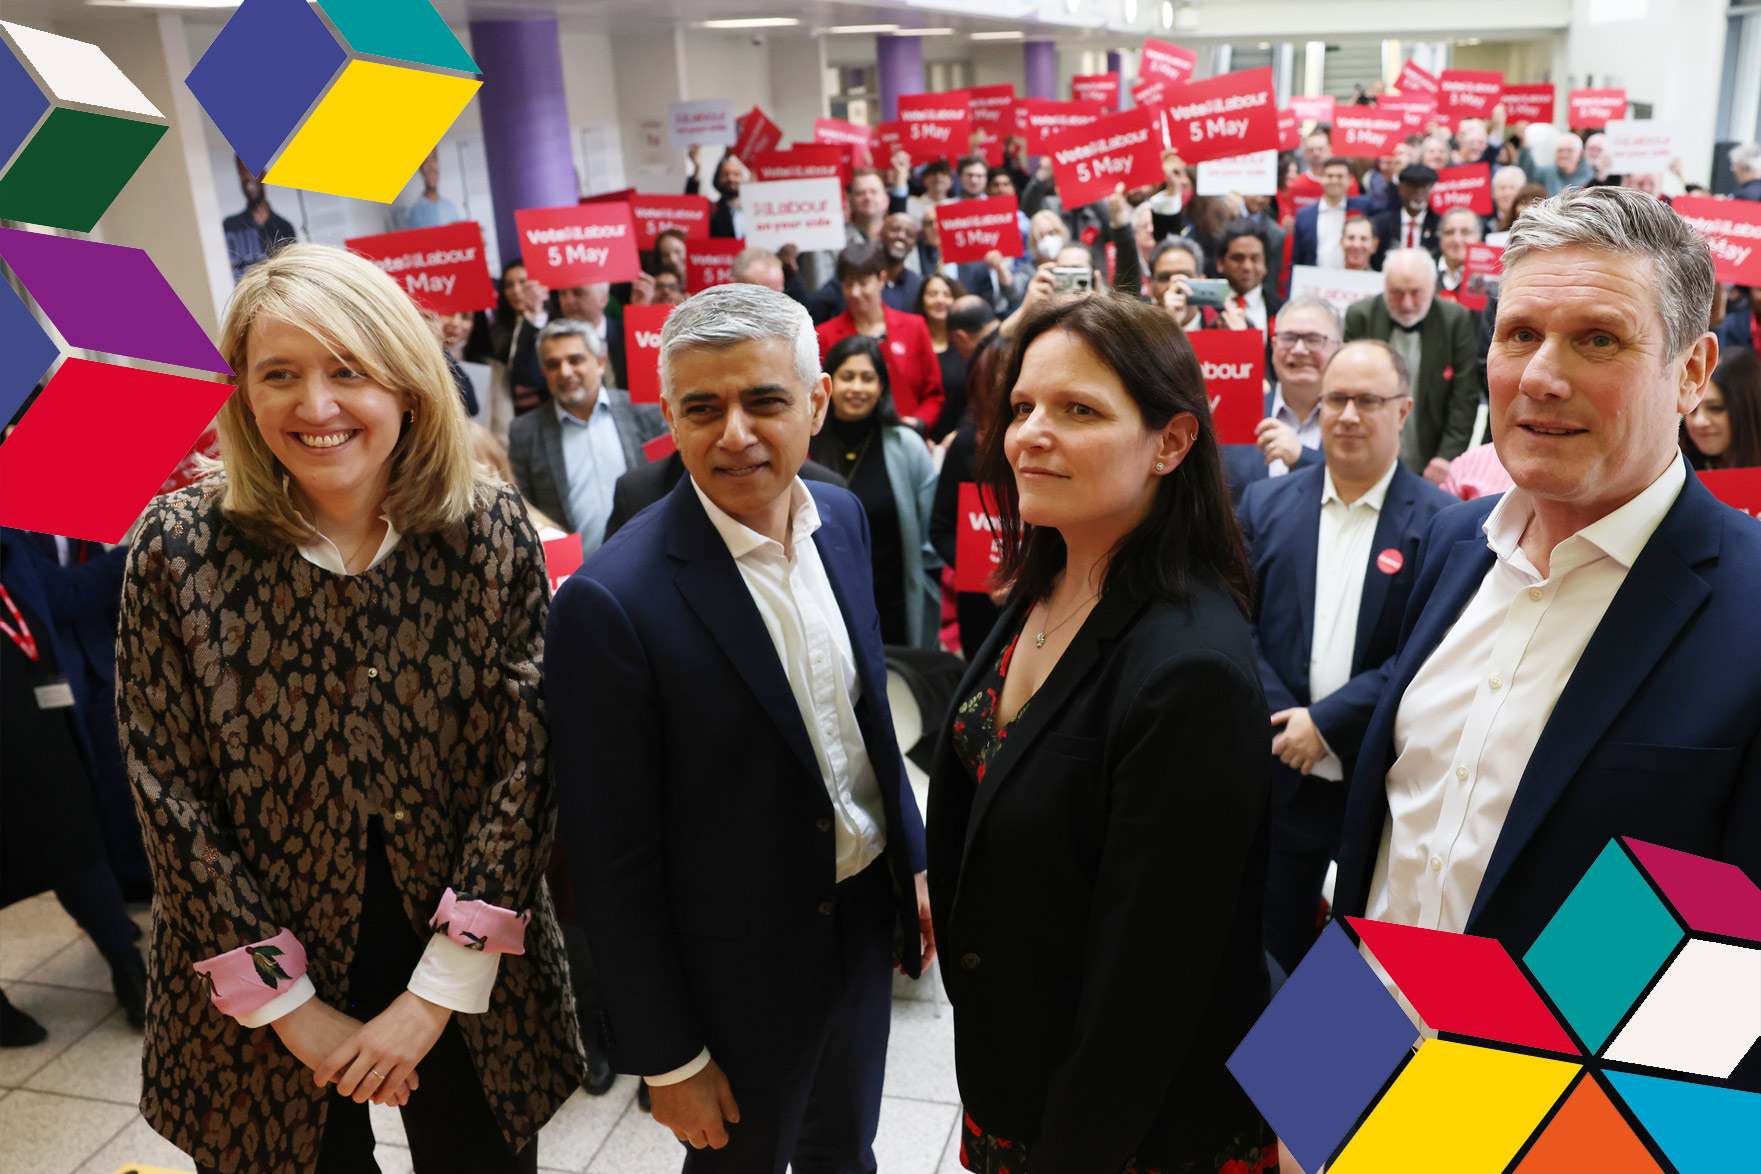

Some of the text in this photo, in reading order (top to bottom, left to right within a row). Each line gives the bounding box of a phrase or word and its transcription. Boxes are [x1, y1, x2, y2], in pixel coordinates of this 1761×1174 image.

[1169, 101, 1205, 121] Vote
[1217, 91, 1268, 113] Labour
[921, 122, 952, 142] May
[1190, 116, 1249, 142] 5 May
[1055, 128, 1148, 165] Vote Labour
[1076, 154, 1134, 183] 5 May
[526, 223, 627, 245] Vote Labour
[954, 229, 1000, 248] 5 May
[415, 246, 477, 268] Labour
[547, 243, 609, 267] 5 May
[405, 271, 456, 296] May
[634, 330, 662, 348] Vo
[1202, 360, 1253, 379] bour
